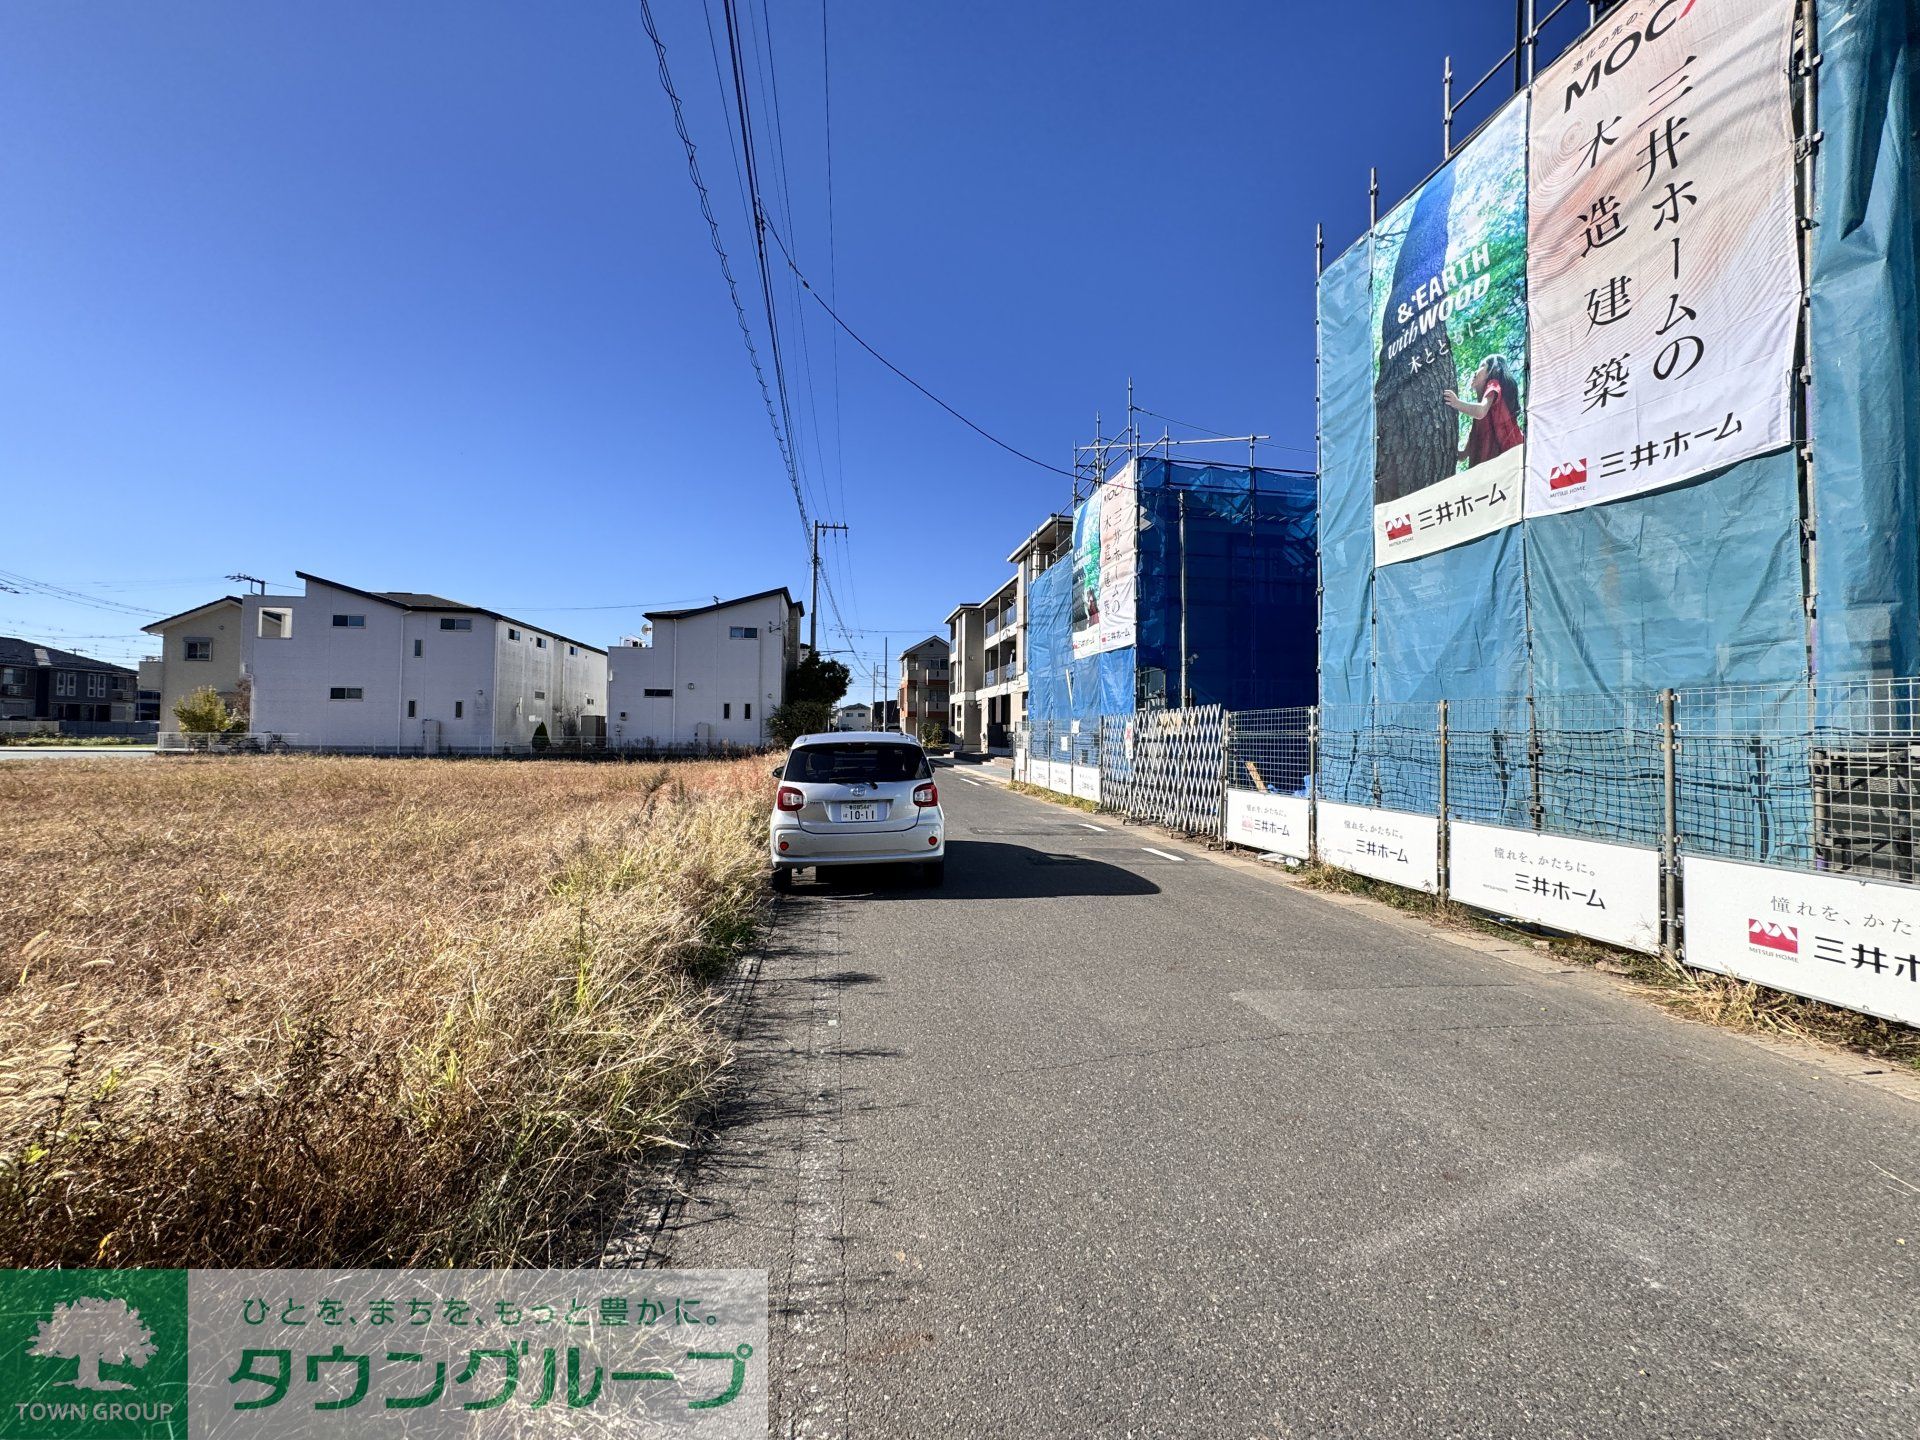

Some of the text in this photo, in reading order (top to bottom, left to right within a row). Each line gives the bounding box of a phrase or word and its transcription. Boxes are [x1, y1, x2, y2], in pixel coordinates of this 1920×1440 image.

[1636, 55, 1705, 381] 三井ホームの
[1573, 115, 1632, 415] 木造建築
[1600, 412, 1743, 478] 三井ホーム
[1418, 483, 1507, 530] 三井ホーム
[1356, 839, 1409, 864] 三井ホーム
[1514, 873, 1606, 910] 三井ホーム
[1770, 895, 1920, 936] 憧れを、かた
[1749, 946, 1799, 964] MITSUI HOME
